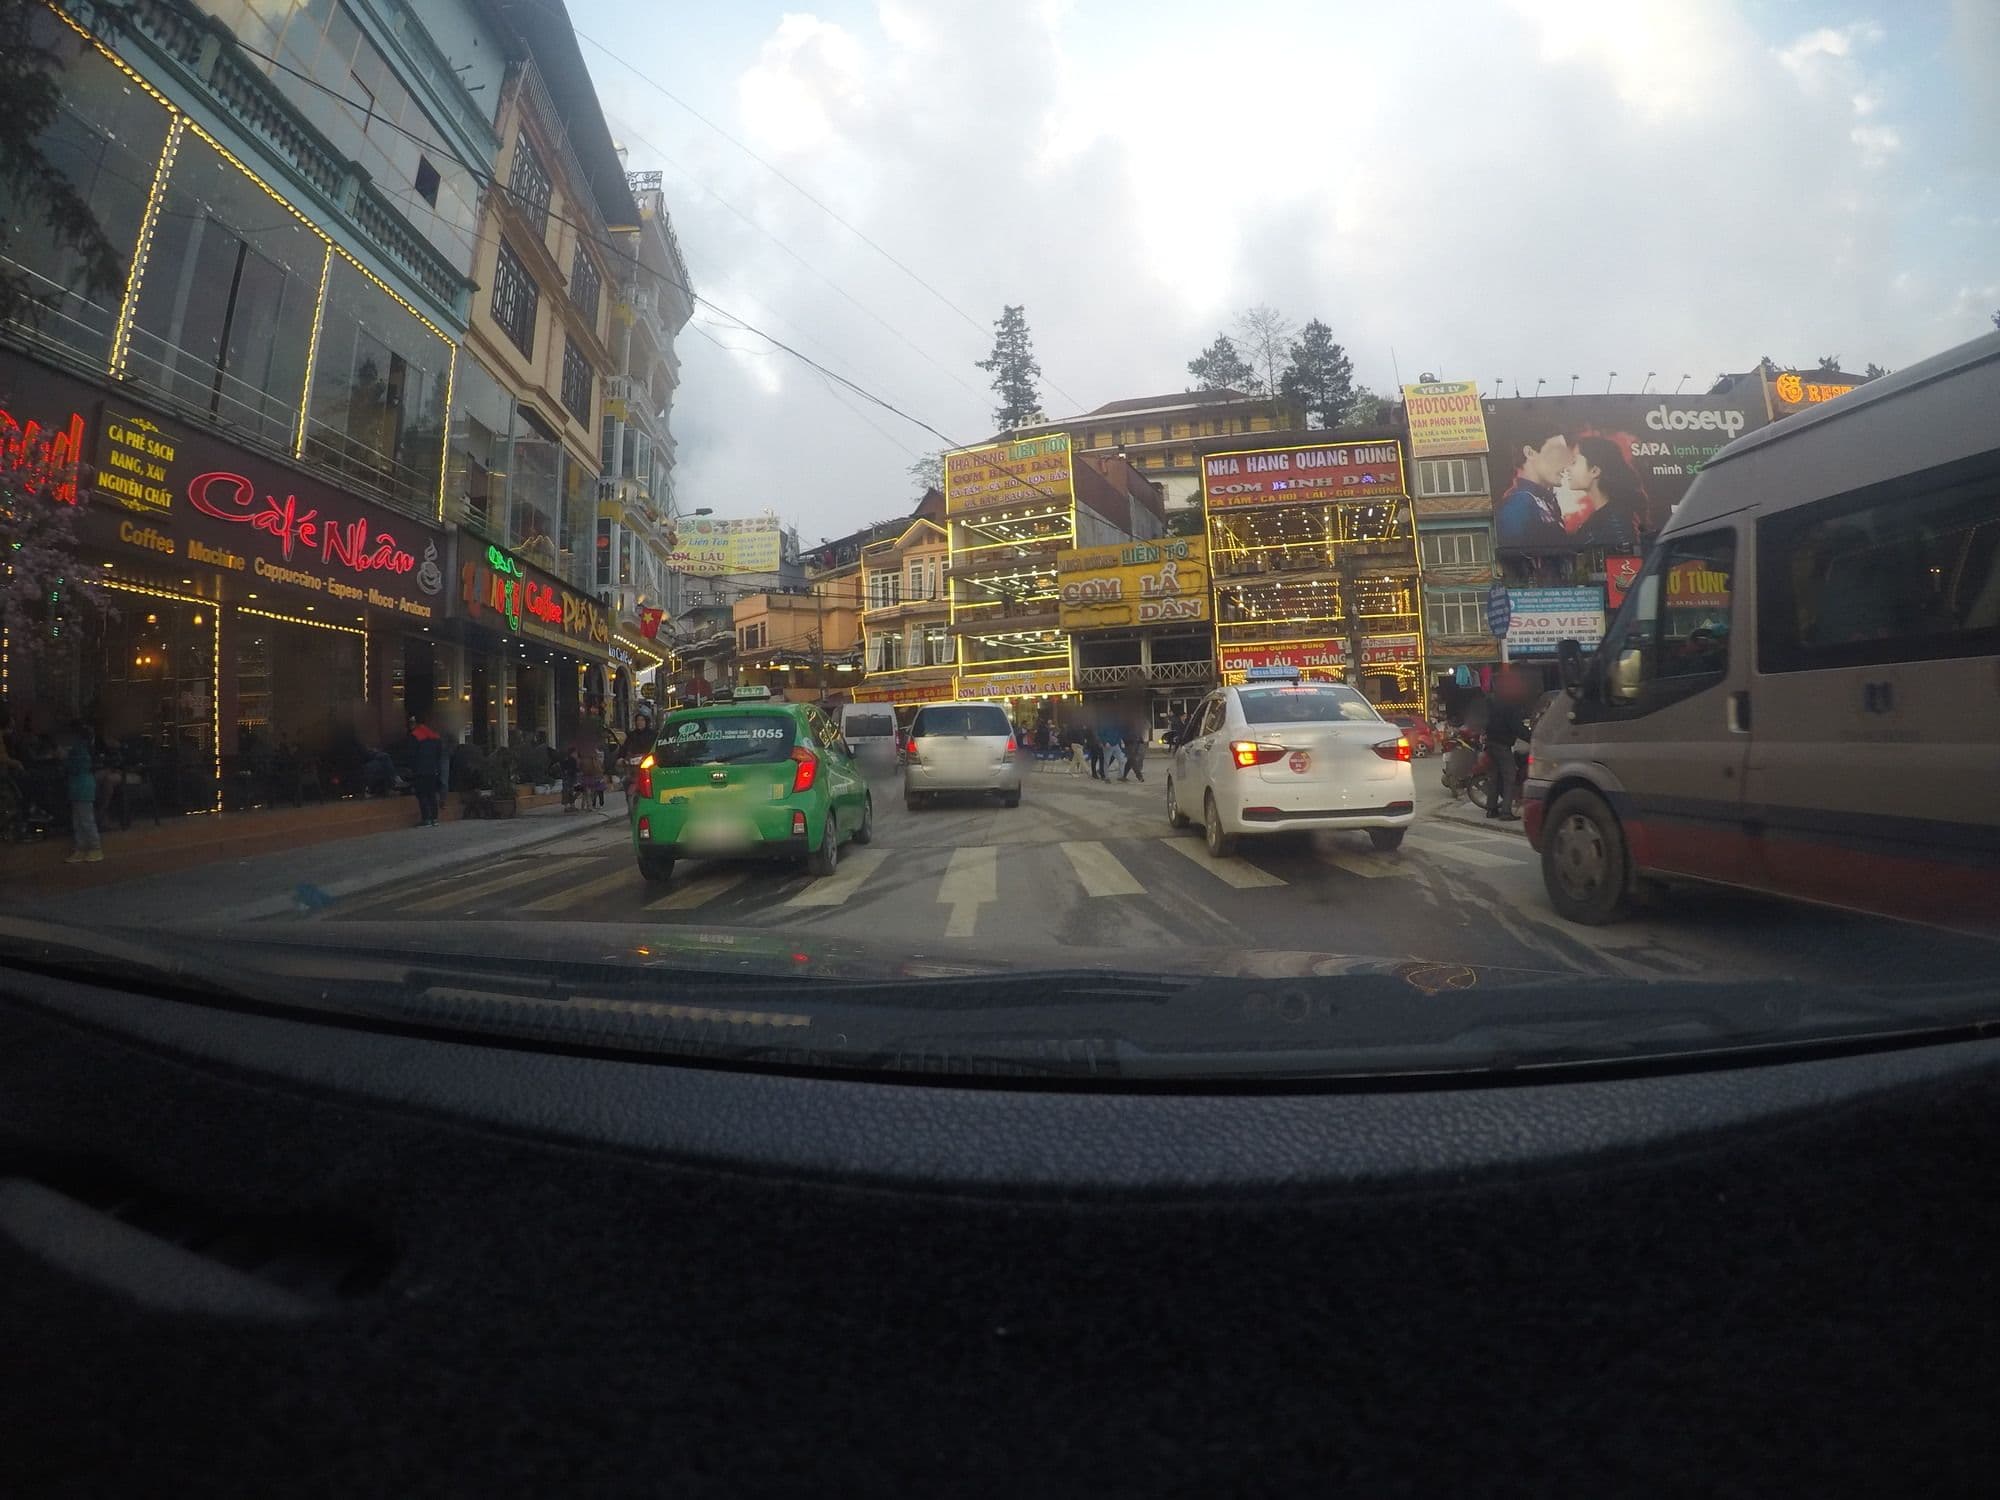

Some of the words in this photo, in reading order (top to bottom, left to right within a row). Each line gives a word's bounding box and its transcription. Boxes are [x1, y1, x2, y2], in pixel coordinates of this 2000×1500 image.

[1408, 394, 1479, 415] PHOTOCOPY
[1645, 404, 1744, 438] closeup
[147, 439, 175, 462] SẠCH
[1296, 449, 1348, 471] QUANG
[1631, 442, 1670, 456] SAPA
[147, 460, 166, 482] XAY
[1653, 463, 1682, 475] mình
[120, 520, 175, 554] Coffee
[188, 539, 246, 571] Machine
[1121, 543, 1160, 566] LIÊN
[254, 557, 322, 590] Cappuccino
[328, 578, 363, 600] Espeso
[369, 588, 394, 609] Moca
[1062, 577, 1122, 607] CƠM
[526, 581, 564, 624] Coffee
[1139, 597, 1202, 622] DÂN
[1509, 616, 1551, 628] SAO
[751, 728, 784, 739] 1055
